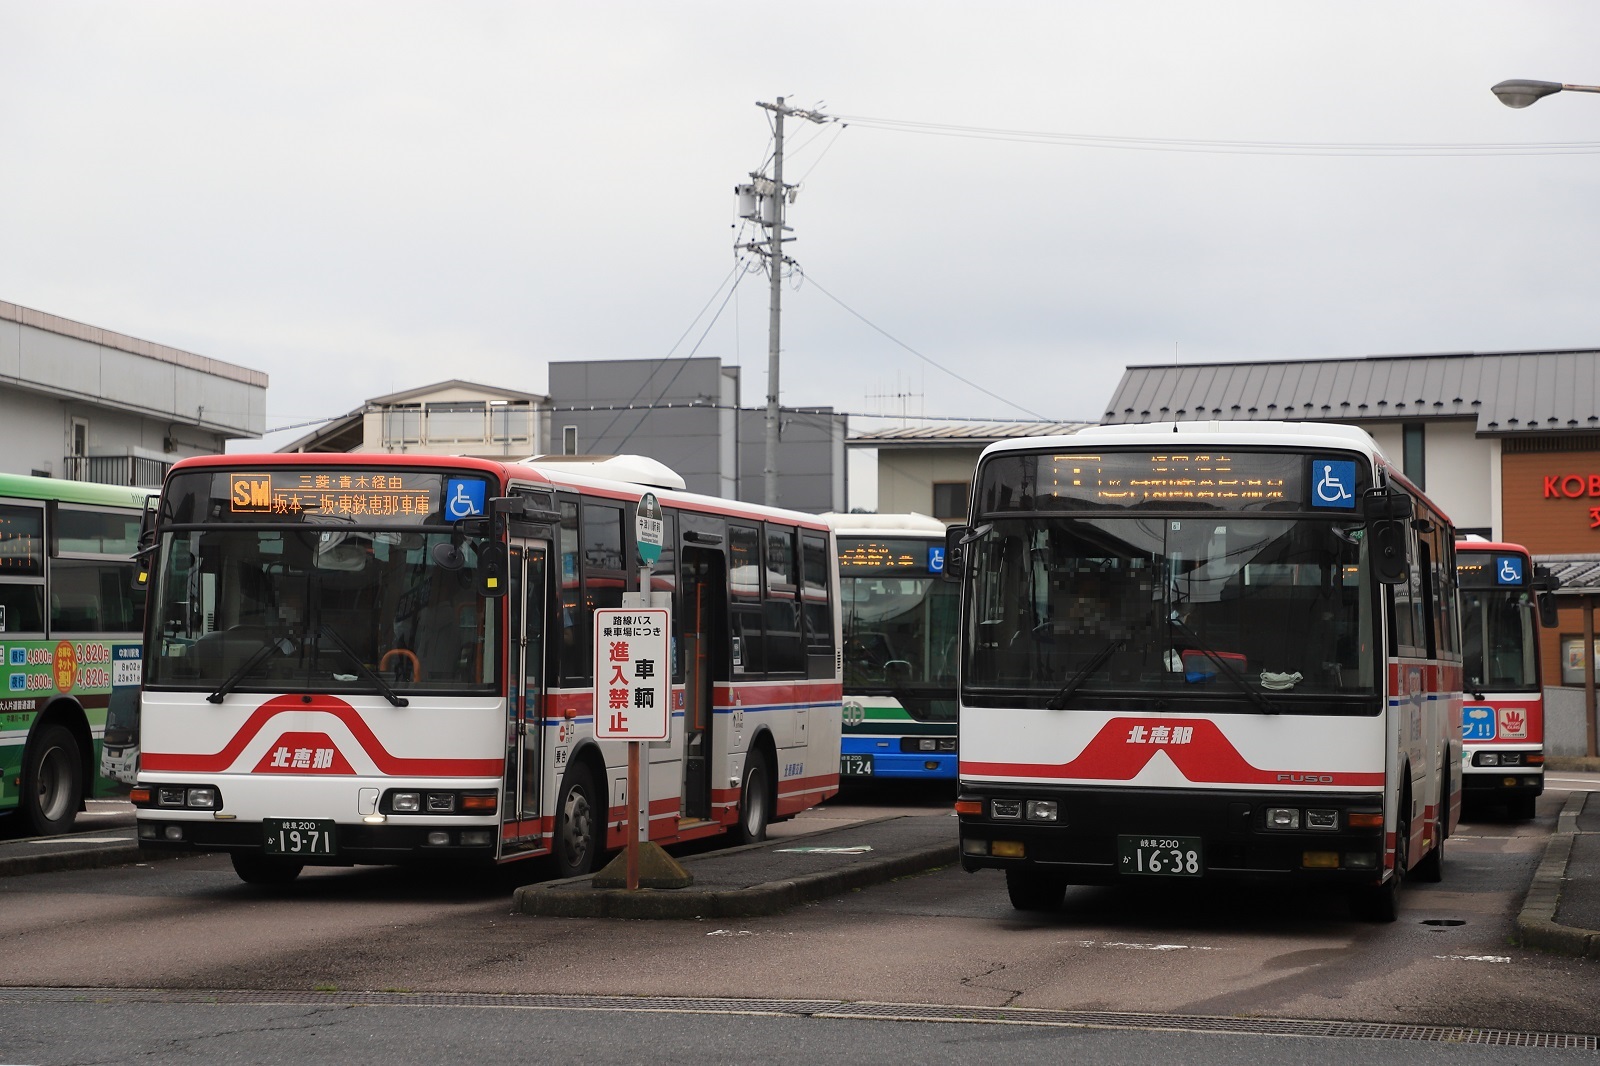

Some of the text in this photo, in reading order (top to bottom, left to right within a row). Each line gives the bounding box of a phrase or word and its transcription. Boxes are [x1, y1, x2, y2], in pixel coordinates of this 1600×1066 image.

[234, 480, 269, 506] SM
[1544, 474, 1600, 498] KOB
[613, 616, 651, 625] 路線バス
[603, 627, 661, 637] 乗車場につき
[609, 641, 629, 732] 進入禁止
[1126, 725, 1194, 745] 北恵那
[270, 747, 335, 769] 北恵那
[1277, 774, 1334, 783] FUSO
[279, 831, 330, 853] 19-71
[1137, 849, 1199, 874] 16-38
